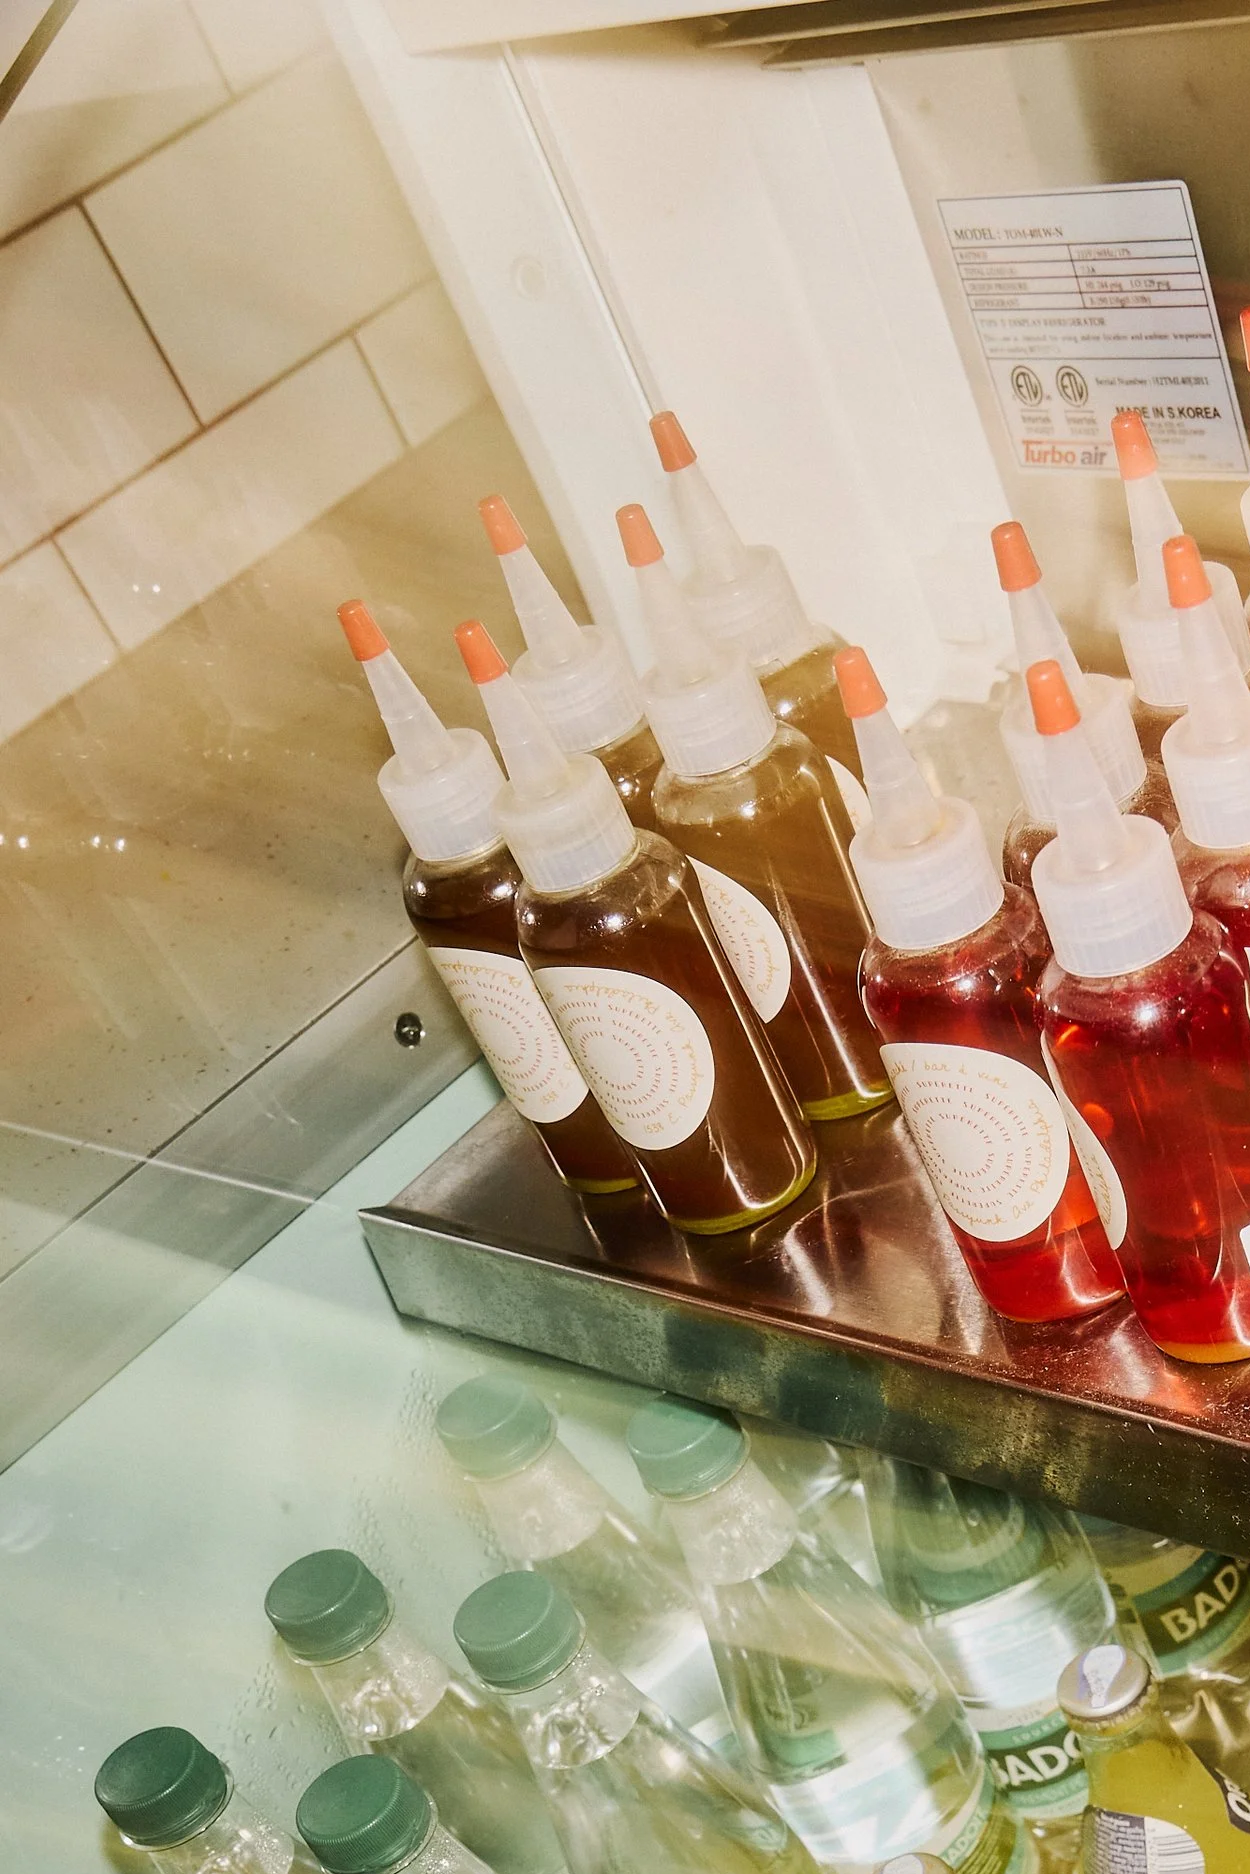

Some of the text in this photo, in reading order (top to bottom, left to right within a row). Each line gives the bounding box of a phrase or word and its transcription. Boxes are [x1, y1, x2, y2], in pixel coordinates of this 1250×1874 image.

[953, 228, 996, 241] MODEL
[1152, 407, 1165, 419] IN
[1167, 406, 1222, 419] S.KOREA
[1022, 440, 1108, 465] Turbo air
[923, 1061, 951, 1073] bar
[1159, 1558, 1249, 1644] BAD
